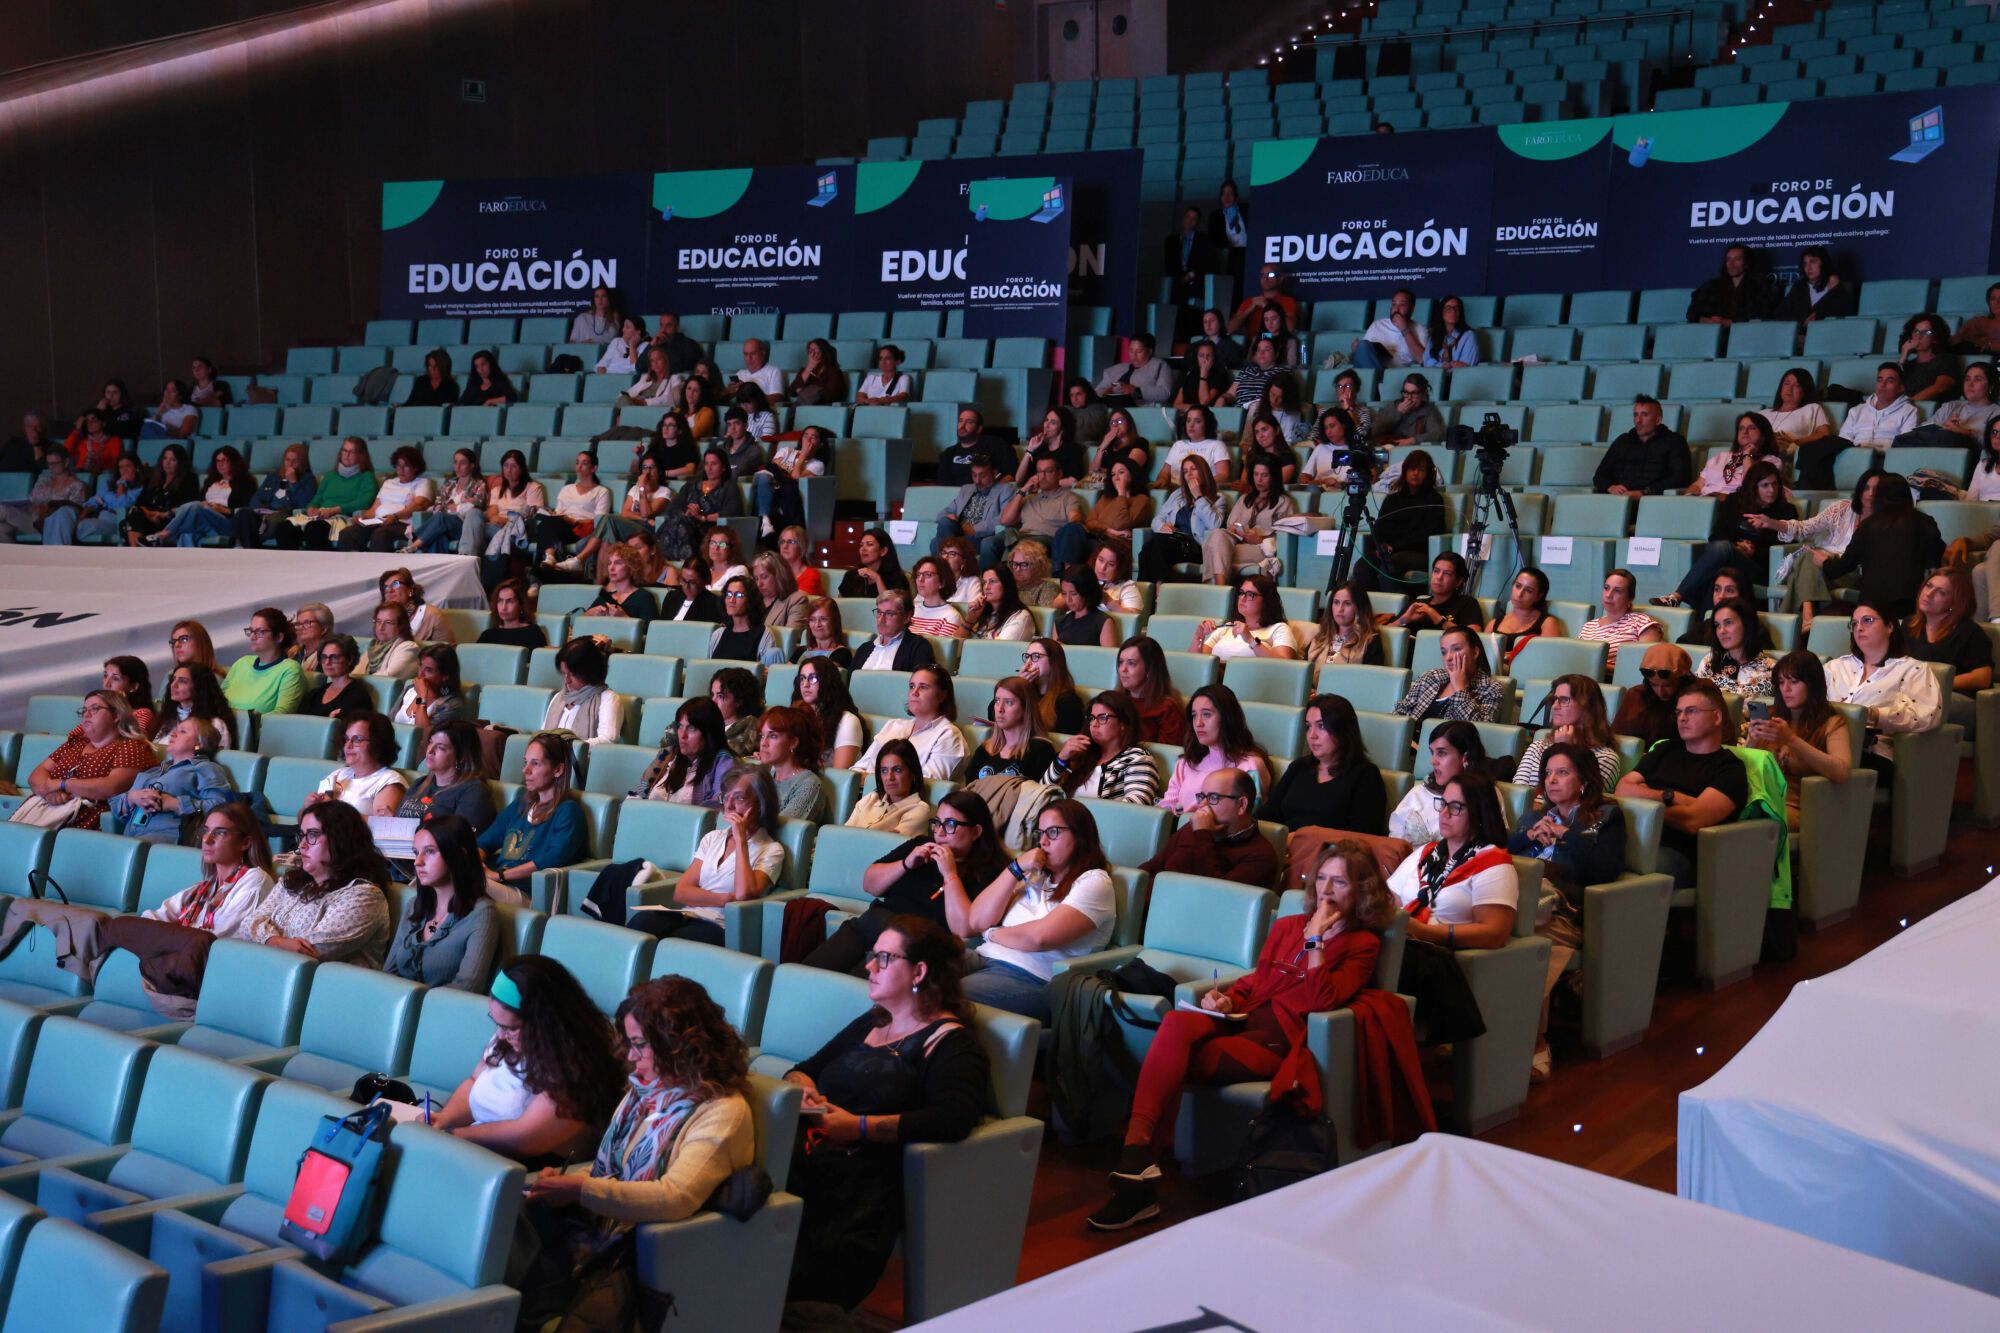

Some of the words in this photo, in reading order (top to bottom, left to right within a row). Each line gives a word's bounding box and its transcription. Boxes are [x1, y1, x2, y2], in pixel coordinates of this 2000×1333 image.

[1327, 168, 1409, 184] FAROEDUCA
[1771, 180, 1810, 193] FORO
[1815, 179, 1833, 190] DE
[479, 200, 547, 213] FAROEDUCA
[1690, 183, 1895, 227] EDUCACIÓN
[1342, 220, 1370, 230] FORO
[1374, 220, 1387, 229] DE
[1496, 219, 1597, 241] EDUCACIÓN
[735, 234, 762, 244] FORO
[765, 234, 778, 243] DE
[1264, 218, 1467, 264] EDUCACIÓN
[485, 249, 519, 259] FORO
[523, 248, 538, 258] DE
[678, 238, 821, 270] EDUCACIÓN
[408, 249, 617, 293] EDUCACIÓN
[923, 292, 941, 300] mayor
[970, 280, 1062, 299] EDUCACIÓN
